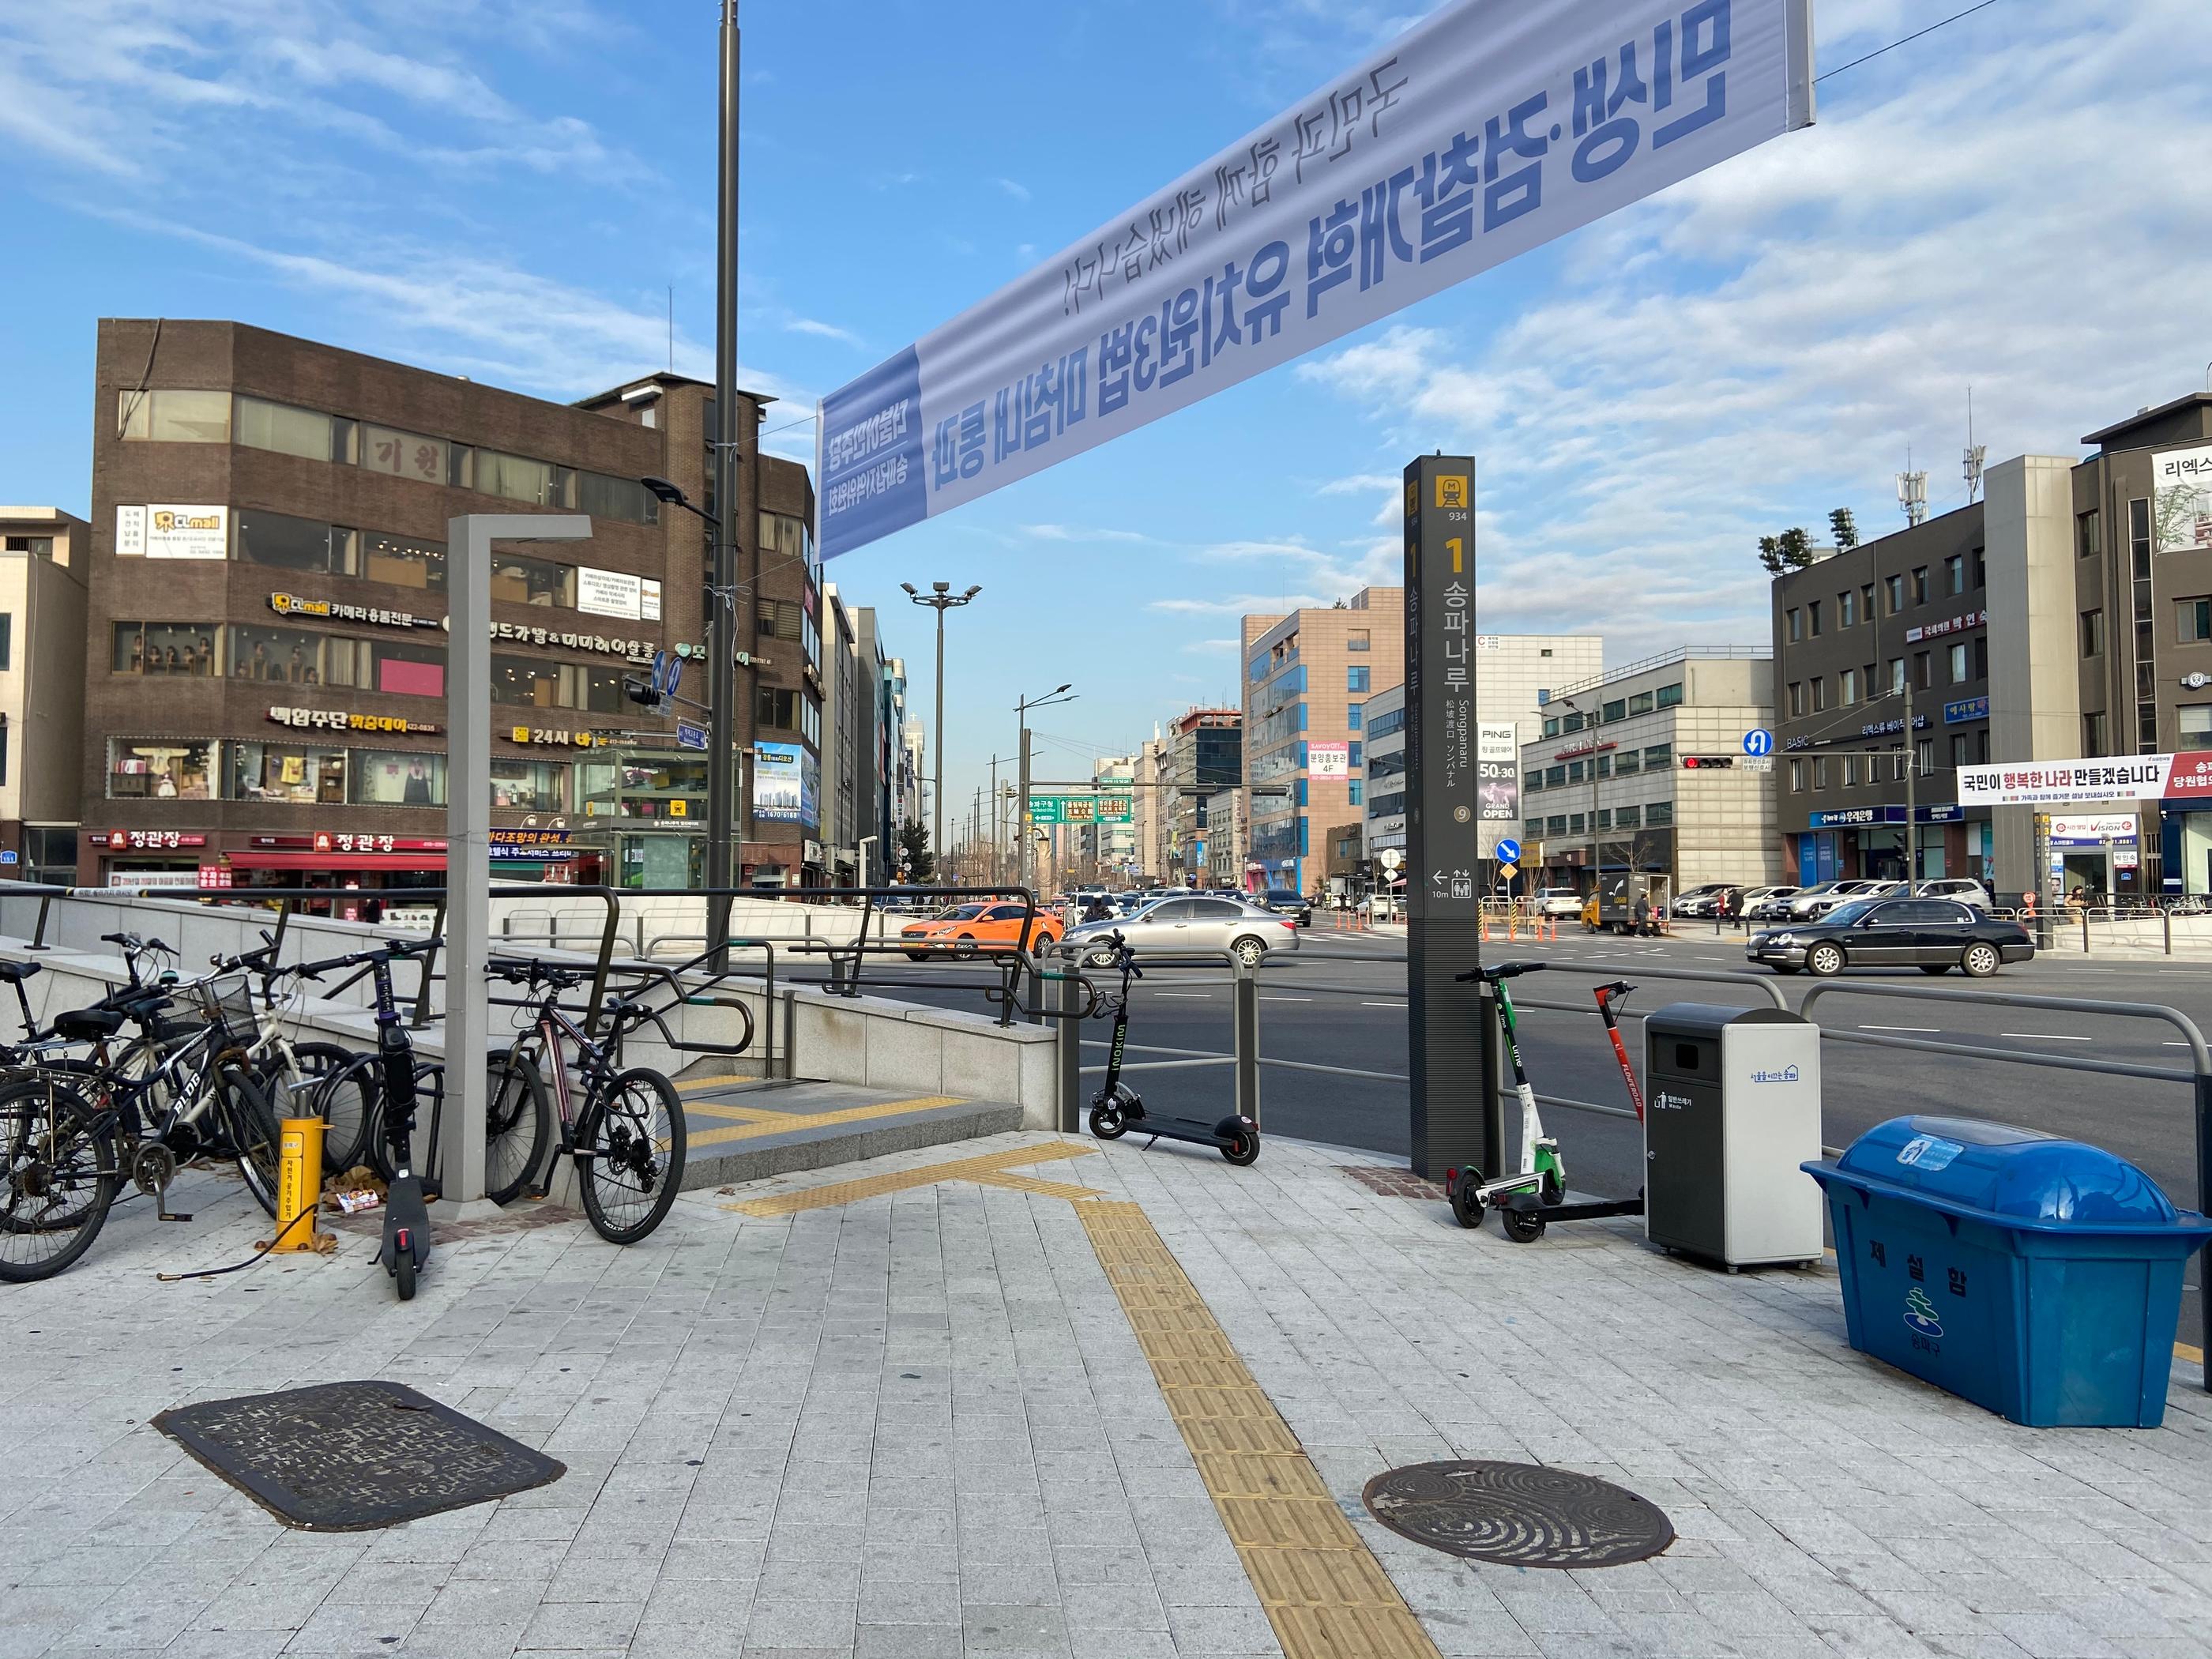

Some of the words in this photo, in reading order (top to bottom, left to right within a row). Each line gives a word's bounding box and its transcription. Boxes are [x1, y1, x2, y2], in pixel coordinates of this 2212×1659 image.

[2165, 457, 2212, 477] 리엑스
[1449, 512, 1467, 521] 934
[1409, 543, 1416, 577] 1
[1445, 538, 1462, 573] 1
[1409, 587, 1419, 696] 송파나루
[1443, 581, 1469, 693] 송파나루
[533, 728, 569, 745] 24시
[1457, 699, 1469, 768] Songpanaru
[1482, 730, 1511, 739] PING
[1787, 735, 1809, 749] BASIC
[1311, 753, 1346, 763] 분양홍보관
[1446, 745, 1455, 788] ソンパナル
[1964, 772, 2000, 791] 국민이
[2003, 769, 2043, 788] 행복한
[2045, 769, 2072, 788] 나라
[2075, 764, 2160, 786] 만들겠습니다
[1483, 809, 1513, 818] OPEN
[1846, 809, 1873, 822] 우리은행
[2090, 821, 2120, 832] VISION
[130, 830, 182, 848] 정관장
[337, 833, 395, 852] 정관장
[1511, 1044, 1522, 1067] Lime
[173, 1072, 201, 1115] BLDG
[1622, 1063, 1642, 1108] FLOWEROAD
[1668, 1094, 1692, 1106] 일반쓰레기
[1911, 1333, 1940, 1358] 송파구
